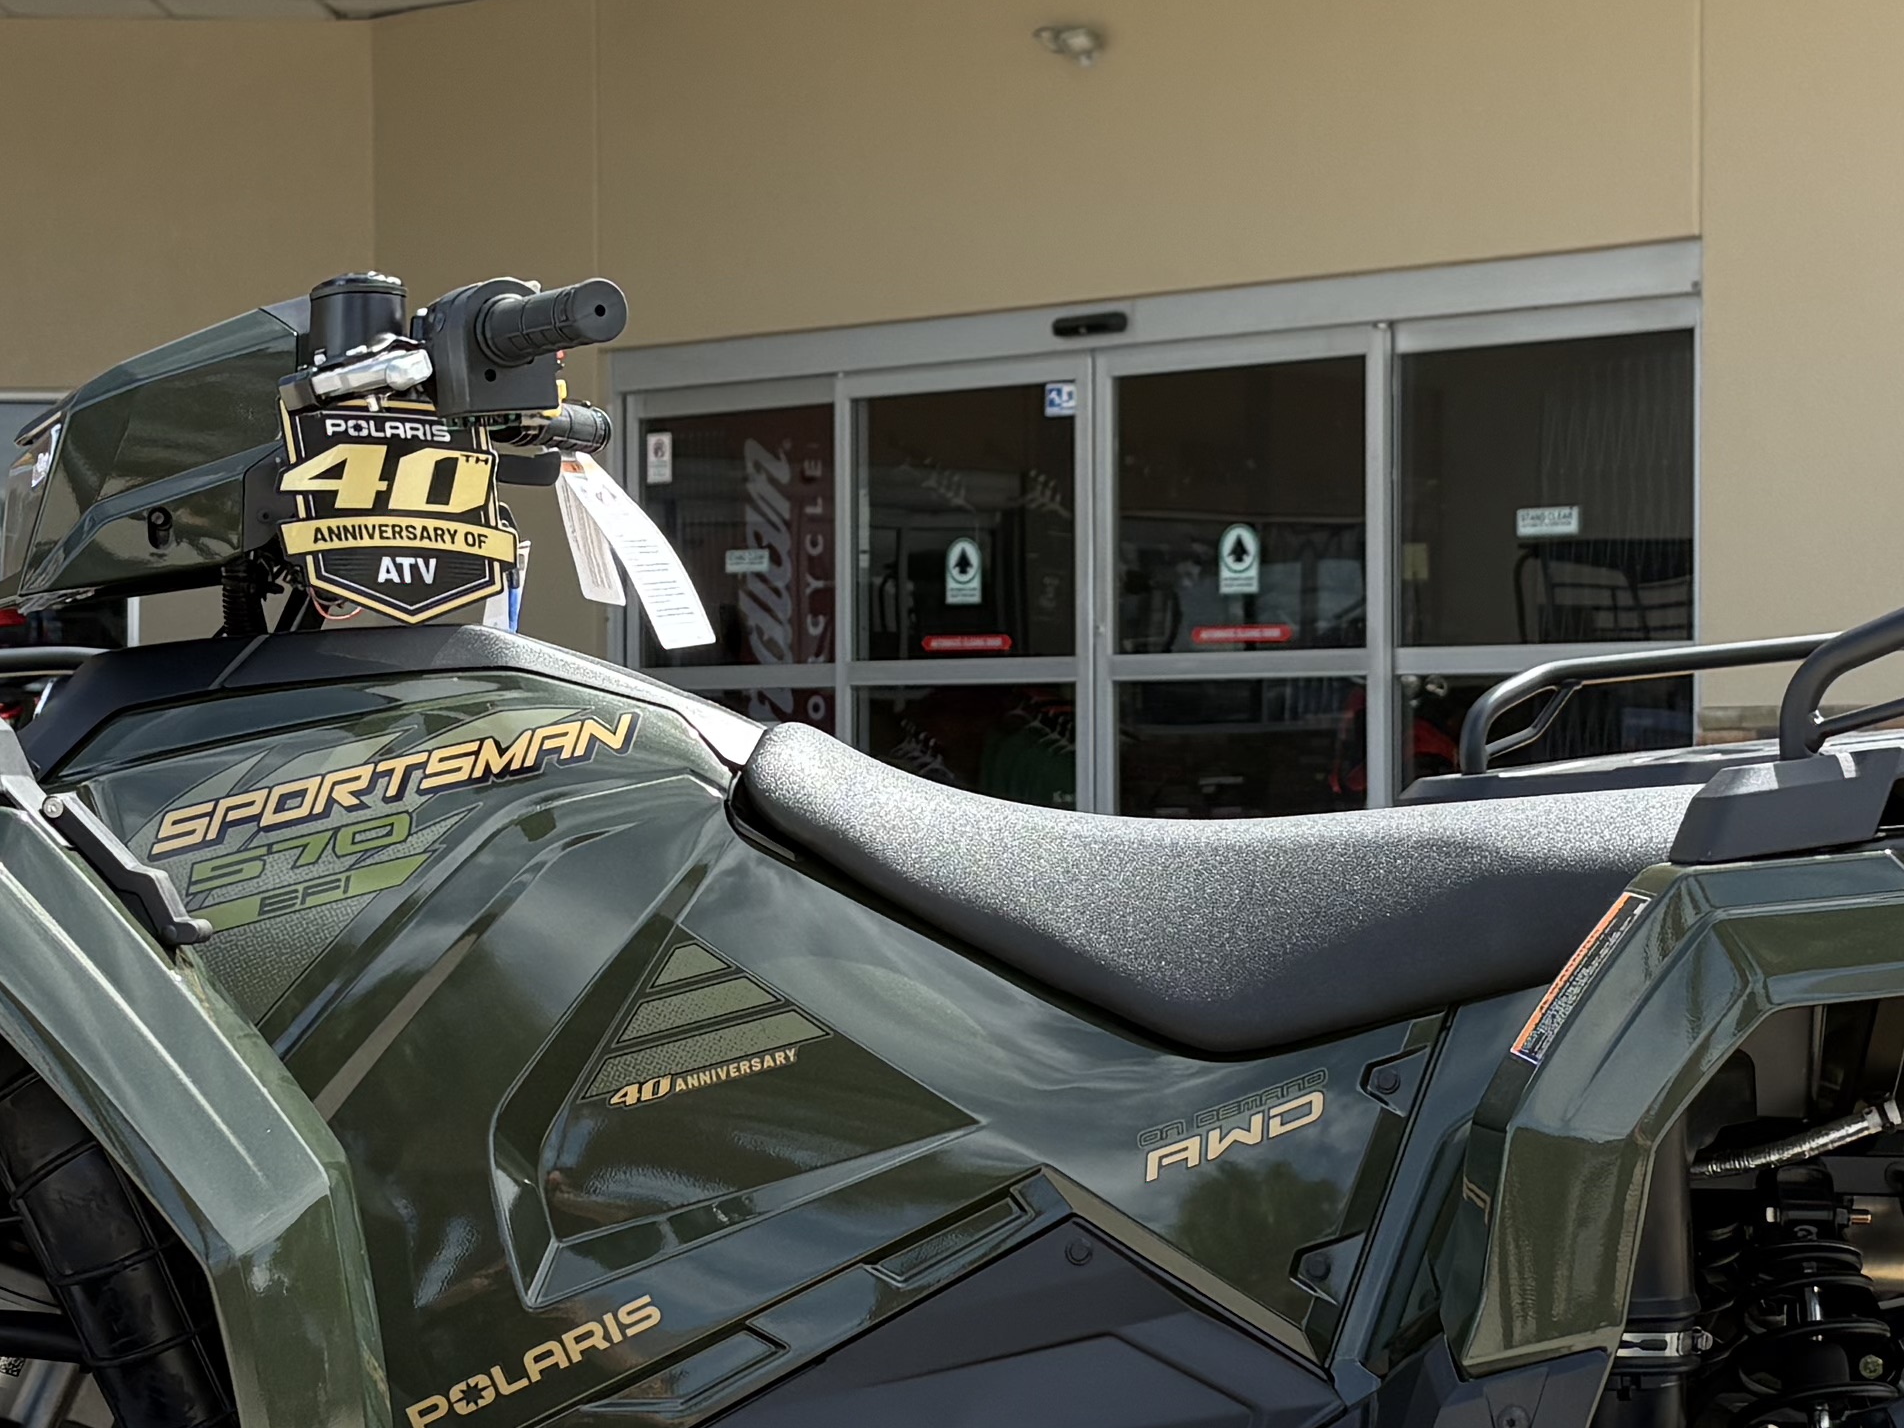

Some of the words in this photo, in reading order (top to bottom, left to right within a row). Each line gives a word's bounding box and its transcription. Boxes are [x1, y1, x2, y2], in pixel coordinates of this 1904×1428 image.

[324, 417, 452, 443] POLARIS
[312, 523, 459, 548] ANNIVERSARY
[463, 529, 489, 550] OF
[376, 555, 438, 585] ATV
[148, 711, 640, 862] SPORTSMAN
[186, 811, 416, 897] 570
[257, 874, 351, 917] EFI
[674, 1047, 797, 1093] ANNIVERSARY
[1138, 1119, 1185, 1149] ON
[1193, 1067, 1328, 1129] DEMAND
[1145, 1090, 1325, 1183] AWD
